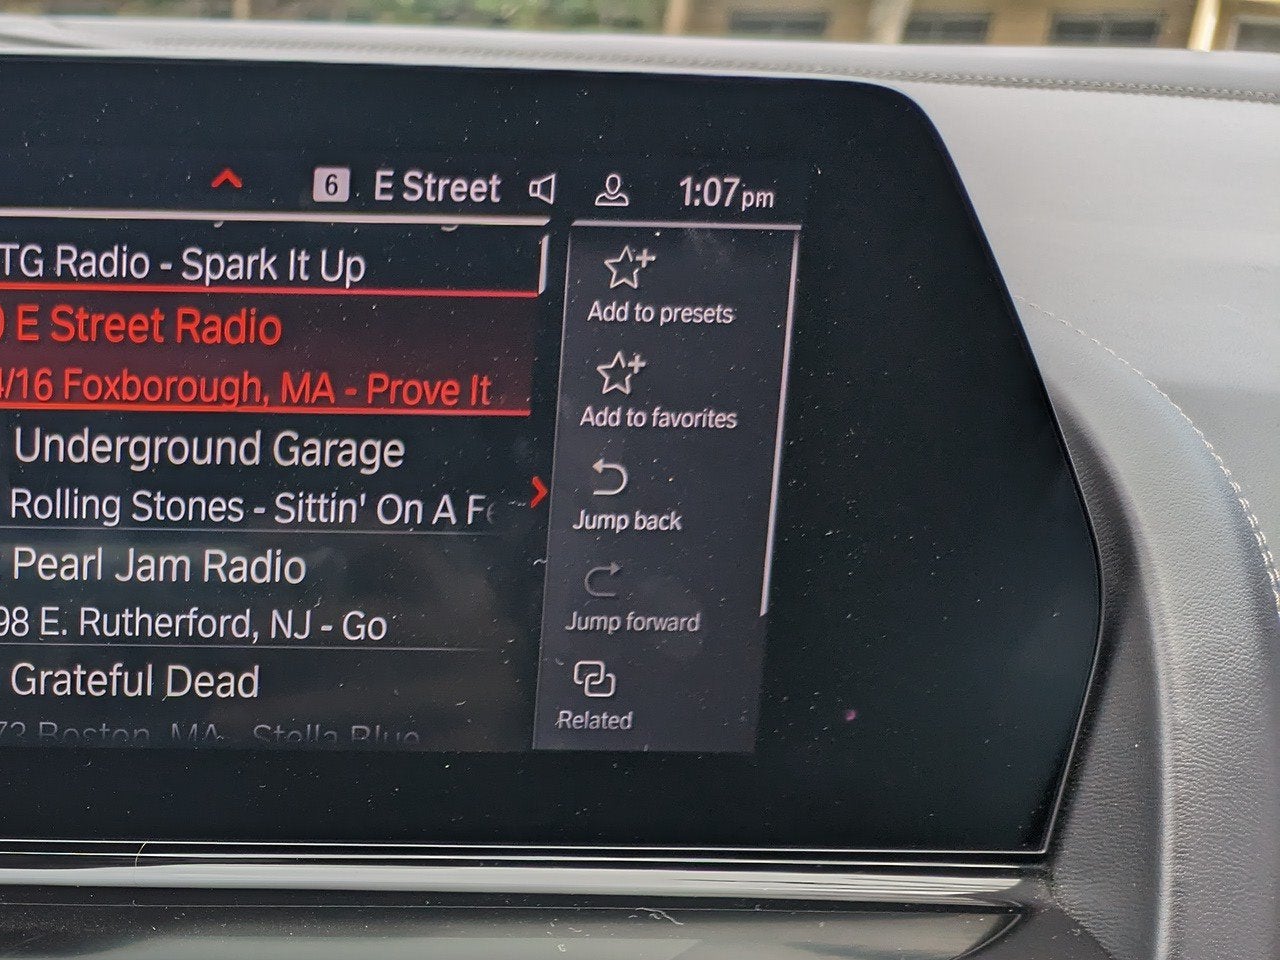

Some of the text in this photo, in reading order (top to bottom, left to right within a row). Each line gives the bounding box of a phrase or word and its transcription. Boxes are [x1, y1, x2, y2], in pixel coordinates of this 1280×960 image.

[324, 174, 338, 198] 6
[375, 171, 501, 203] E Street
[56, 245, 150, 279] Radio
[181, 247, 277, 286] Spark
[289, 248, 310, 281] It
[320, 249, 366, 289] Up
[17, 305, 39, 341] E
[51, 306, 164, 344] Street
[176, 307, 282, 345] Radio
[587, 301, 734, 326] Add to presets
[64, 368, 270, 408] Foxborough,
[281, 371, 335, 404] MA
[367, 372, 461, 406] Prove
[470, 374, 492, 406] It
[580, 405, 738, 429] Add to favorites
[15, 426, 262, 472] Underground
[274, 430, 405, 475] Garage
[11, 488, 120, 527] Rolling
[132, 489, 244, 523] Stones
[274, 491, 366, 524] Sittin'
[376, 494, 422, 525] On
[432, 494, 457, 525] A
[572, 509, 683, 533] Jump back
[13, 546, 103, 581] Pearl
[115, 548, 191, 582] Jam
[204, 549, 306, 585] Radio
[40, 606, 67, 637] E.
[79, 606, 259, 644] Rutherford,
[271, 609, 311, 641] NJ
[343, 610, 388, 641] Go
[565, 611, 701, 636] Jump forward
[12, 662, 153, 696] Grateful
[166, 665, 260, 699] Dead
[558, 711, 633, 730] Related
